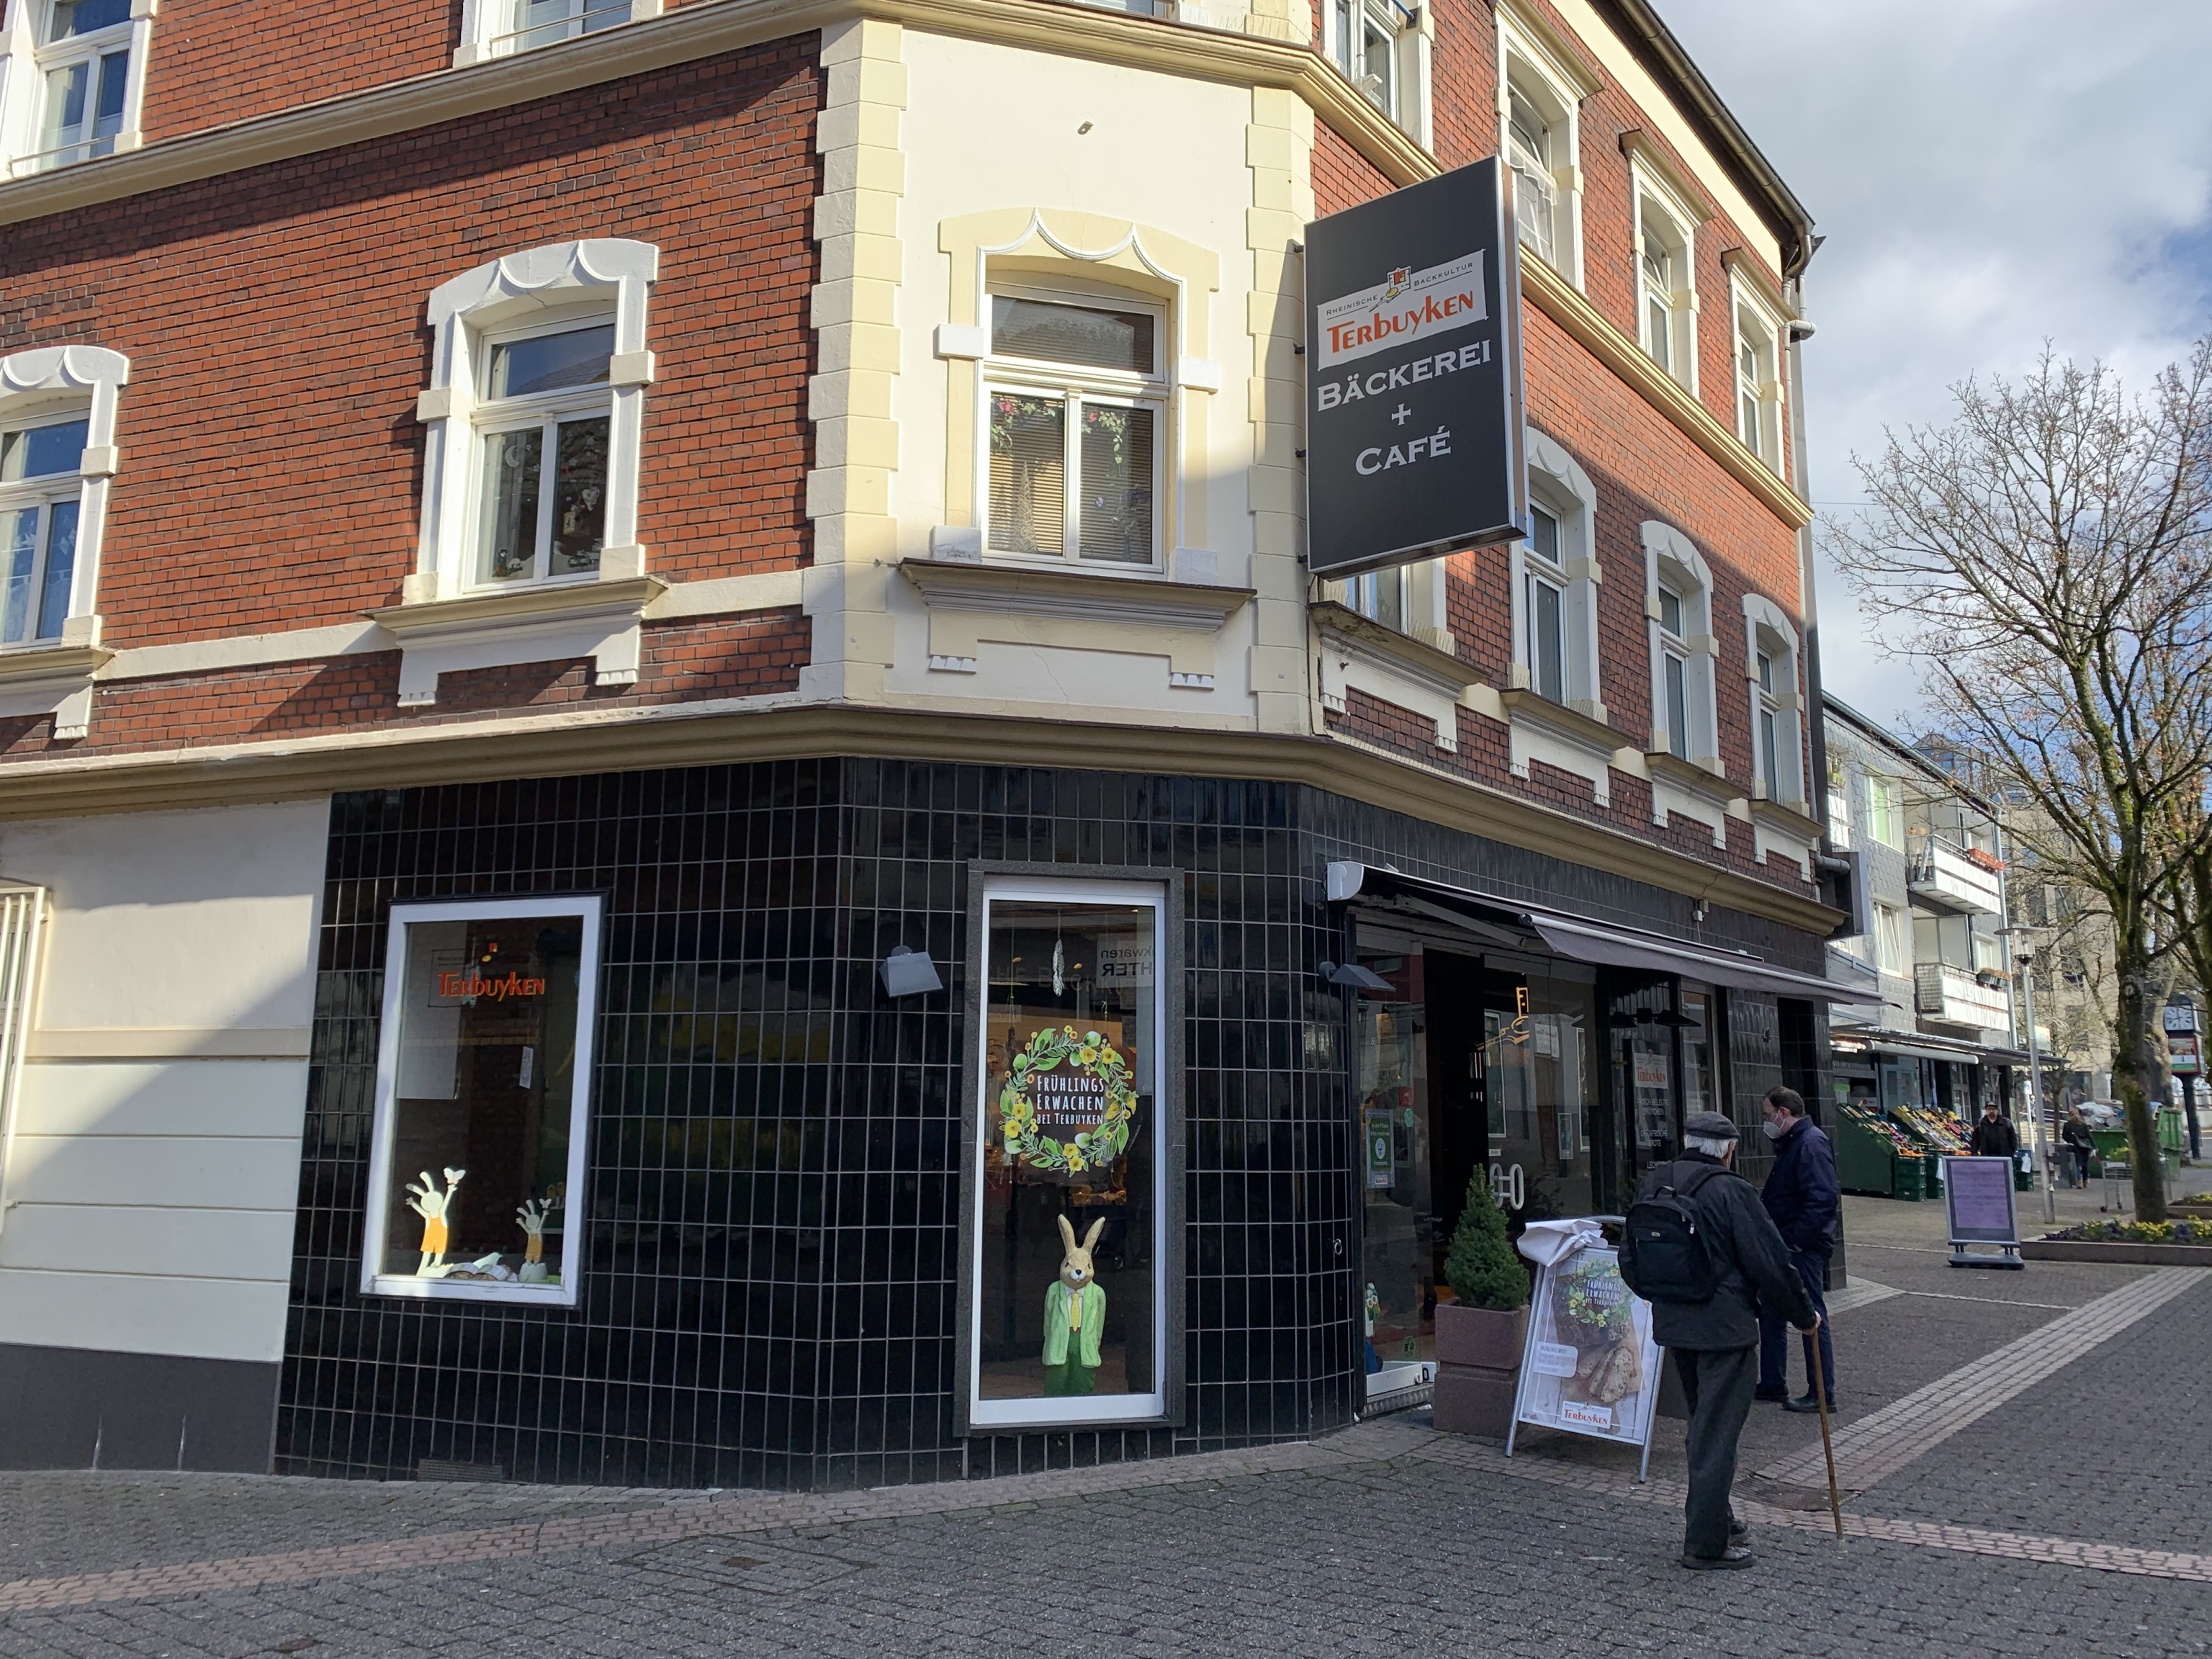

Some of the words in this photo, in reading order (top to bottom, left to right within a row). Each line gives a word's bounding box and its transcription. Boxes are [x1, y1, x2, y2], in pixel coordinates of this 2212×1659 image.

[1326, 294, 1378, 316] RHEINISCHE
[1413, 261, 1474, 287] BACKKULTUR
[1317, 339, 1491, 412] BÄCKEREI
[1355, 425, 1452, 475] CAFÉ
[1037, 1074, 1105, 1093] FRÜHLINGS
[1037, 1094, 1104, 1111] ERWACHEN
[1037, 1113, 1051, 1125] BEI
[1054, 1112, 1104, 1125] TERBUYKEN
